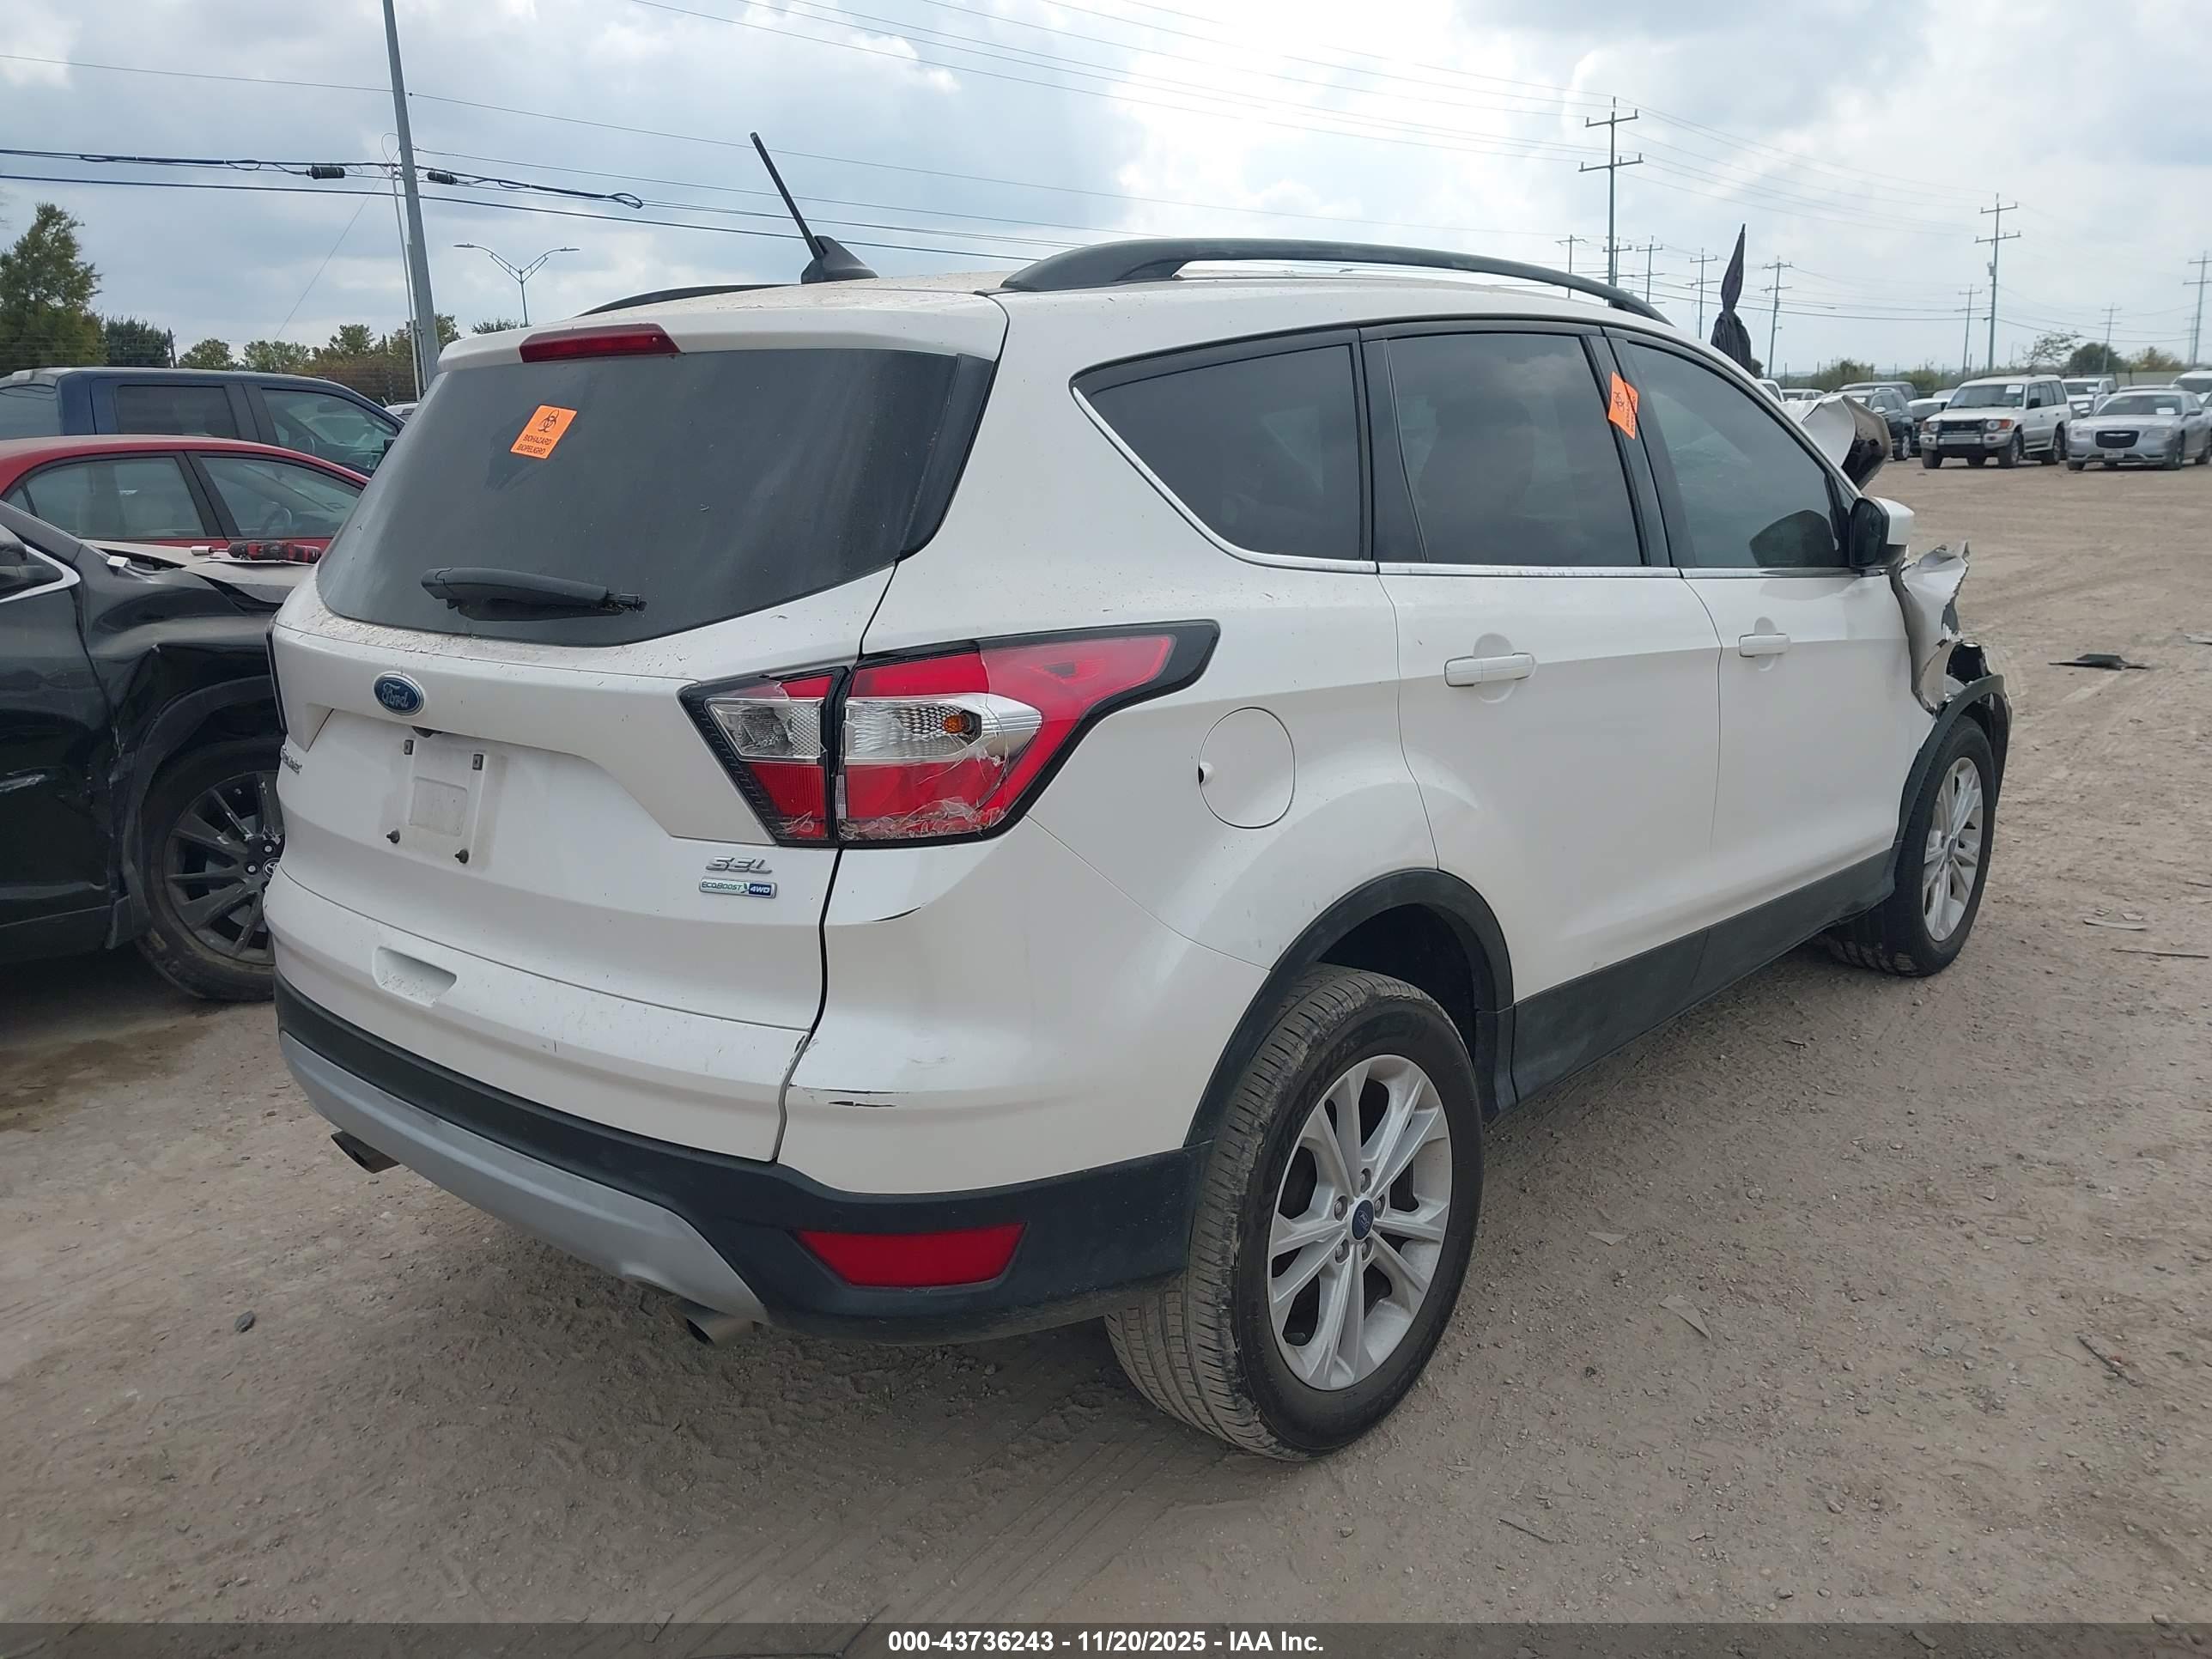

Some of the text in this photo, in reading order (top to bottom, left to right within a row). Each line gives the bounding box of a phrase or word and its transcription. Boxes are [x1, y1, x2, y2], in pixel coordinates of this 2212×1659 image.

[523, 434, 552, 445] BIOHAZARD
[381, 682, 409, 708] Ford
[705, 856, 772, 874] SEL
[750, 884, 770, 894] 4WD
